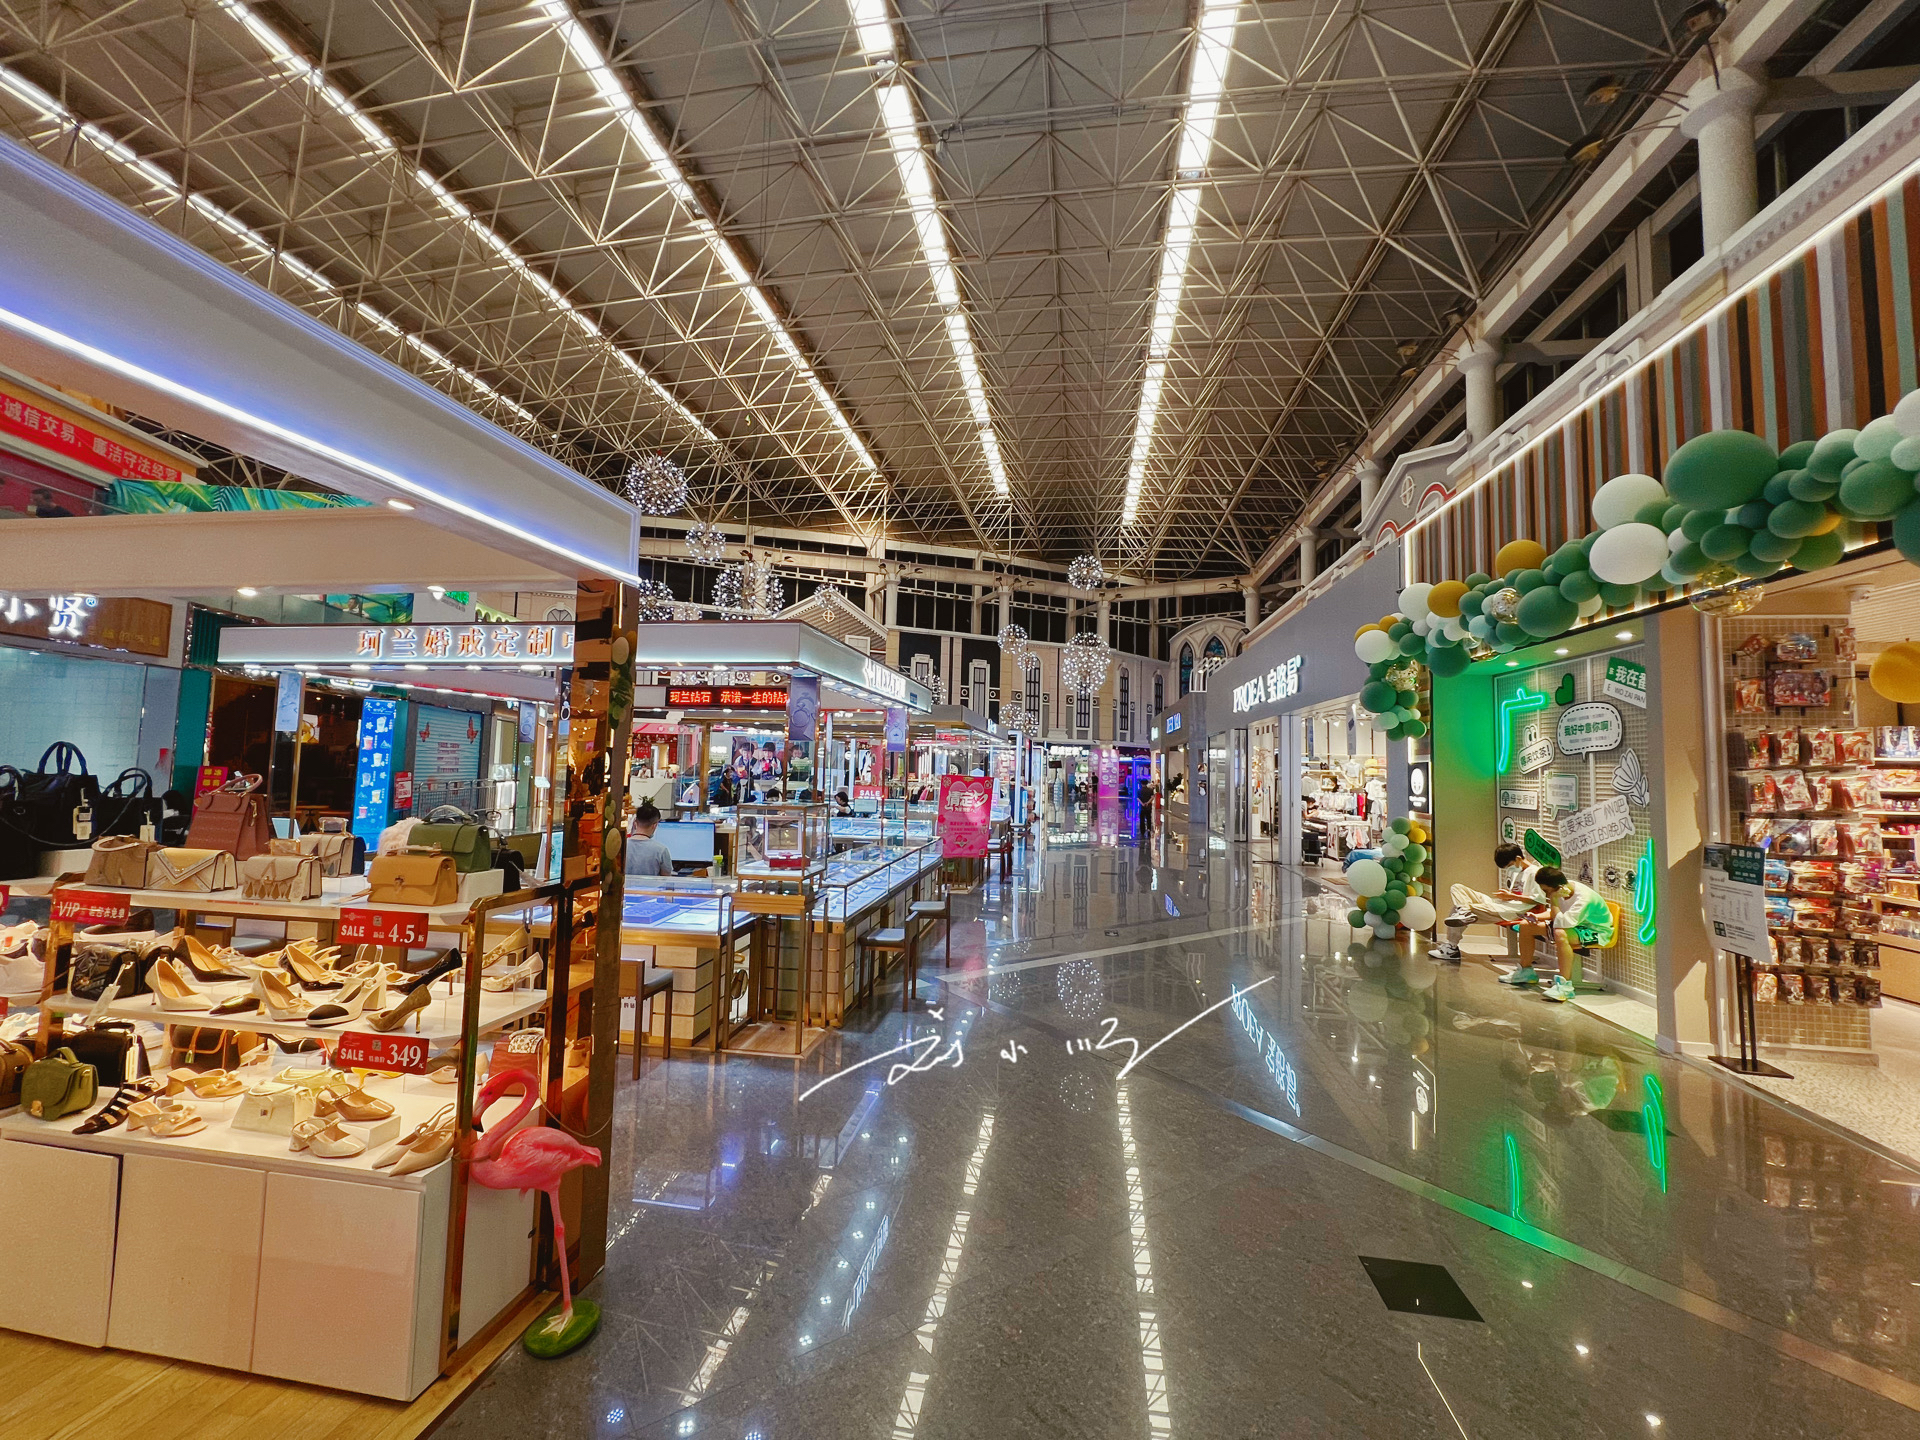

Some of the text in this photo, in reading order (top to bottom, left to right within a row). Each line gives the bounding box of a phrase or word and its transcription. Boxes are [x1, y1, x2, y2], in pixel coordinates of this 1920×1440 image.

[669, 691, 712, 703] 珂兰钻石
[859, 789, 881, 797] SALE
[1563, 817, 1633, 855] 吹吹珠江的晚风
[58, 901, 81, 918] VIP
[341, 924, 365, 937] SALE
[388, 923, 415, 944] 4.5
[340, 1047, 364, 1061] SALE
[386, 1043, 421, 1067] 349
